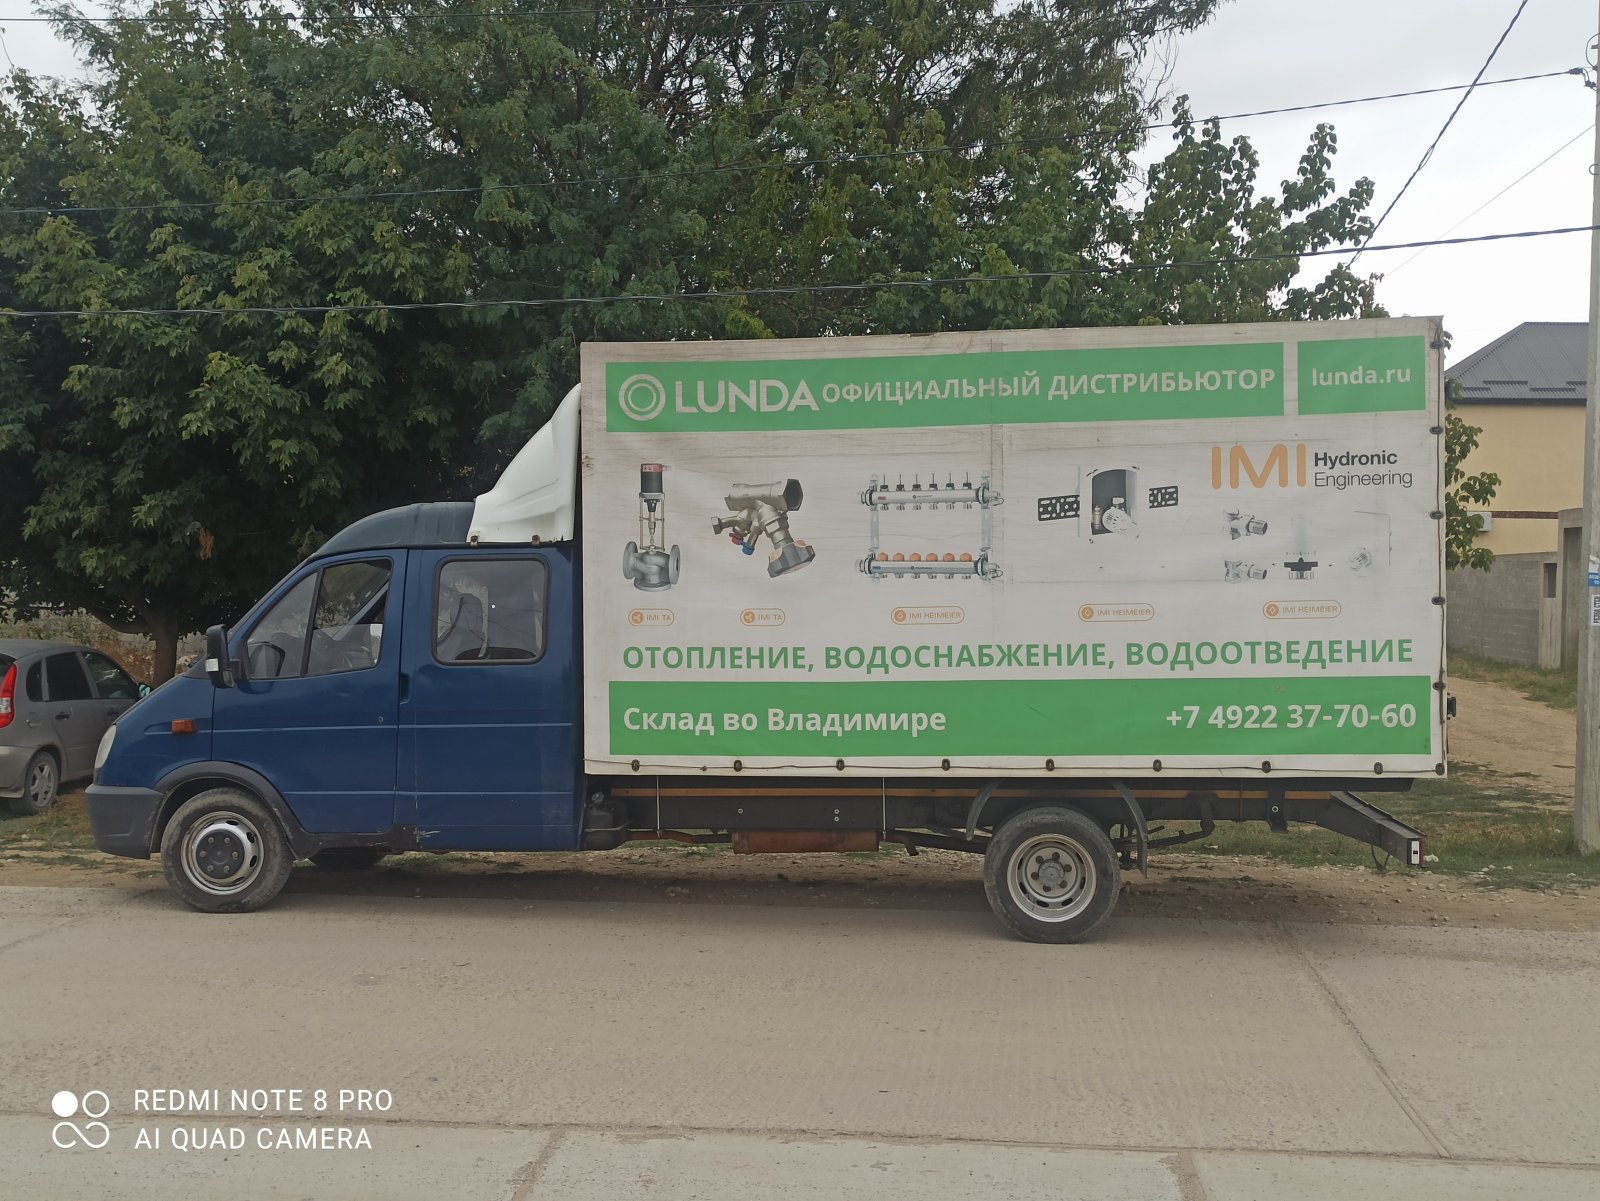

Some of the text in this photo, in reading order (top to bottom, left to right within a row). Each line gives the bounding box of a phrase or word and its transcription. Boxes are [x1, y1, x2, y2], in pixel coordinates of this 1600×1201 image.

[822, 368, 1275, 405] ОФИЦИАЛЬНЫЙ ДИСТРИБЬЮТОР
[1312, 366, 1411, 386] lunda.ru
[675, 378, 819, 413] LUNDA
[1211, 443, 1307, 490] IMI
[1314, 449, 1398, 469] Hydronic
[1314, 470, 1413, 491] Engineering
[909, 610, 961, 620] IMI HEIMEIER
[1097, 607, 1151, 617] IMI HEIMEIER
[1282, 604, 1338, 614] IMI HEIMEIER
[623, 639, 1413, 674] ОТОПЛЕНИЕ, ВОДОСНАБЖЕНИЕ, ВОДООТВЕДЕНИЕ
[623, 707, 946, 737] Склад во Владимире
[1166, 703, 1416, 729] +7 4922 37-70-60
